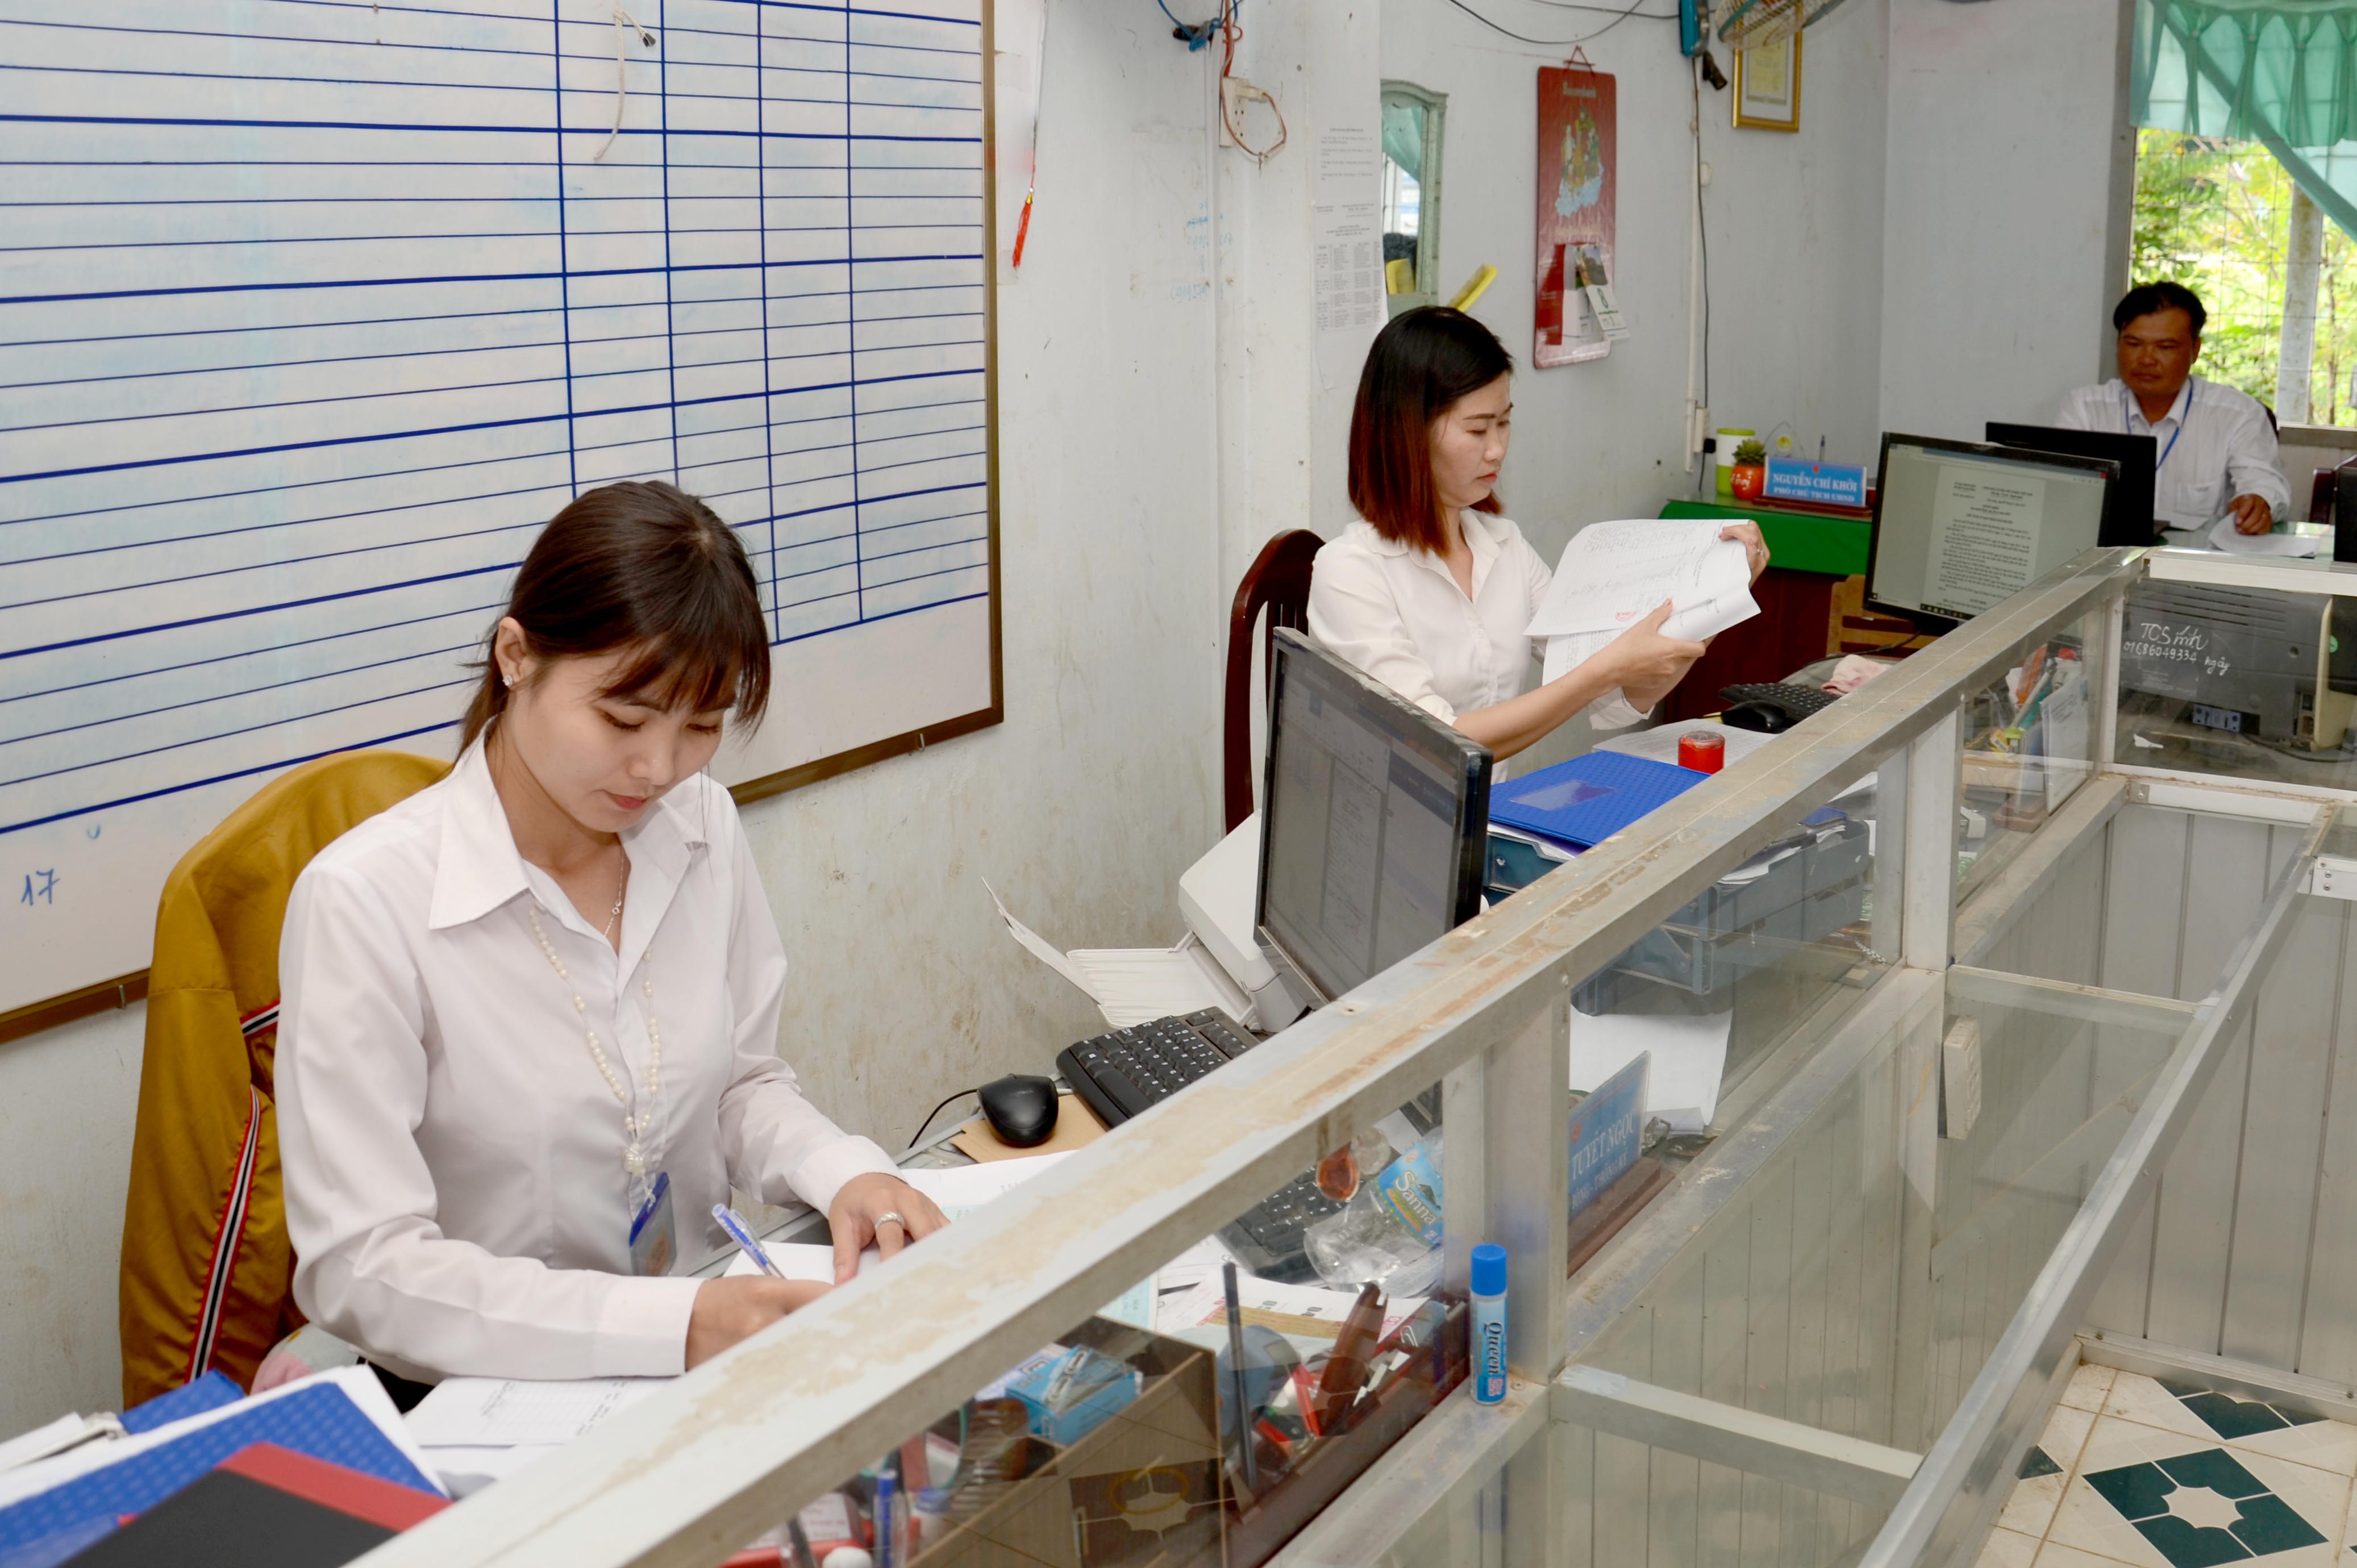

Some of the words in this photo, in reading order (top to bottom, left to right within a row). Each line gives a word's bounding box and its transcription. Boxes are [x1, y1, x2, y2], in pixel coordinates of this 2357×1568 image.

[1813, 477, 1831, 489] CHÍ
[21, 868, 60, 906] 17
[1572, 1126, 1606, 1180] TUYẾT
[1608, 1108, 1637, 1152] NGỌC
[1394, 1170, 1436, 1225] Sanna
[1484, 1322, 1502, 1373] Queen
